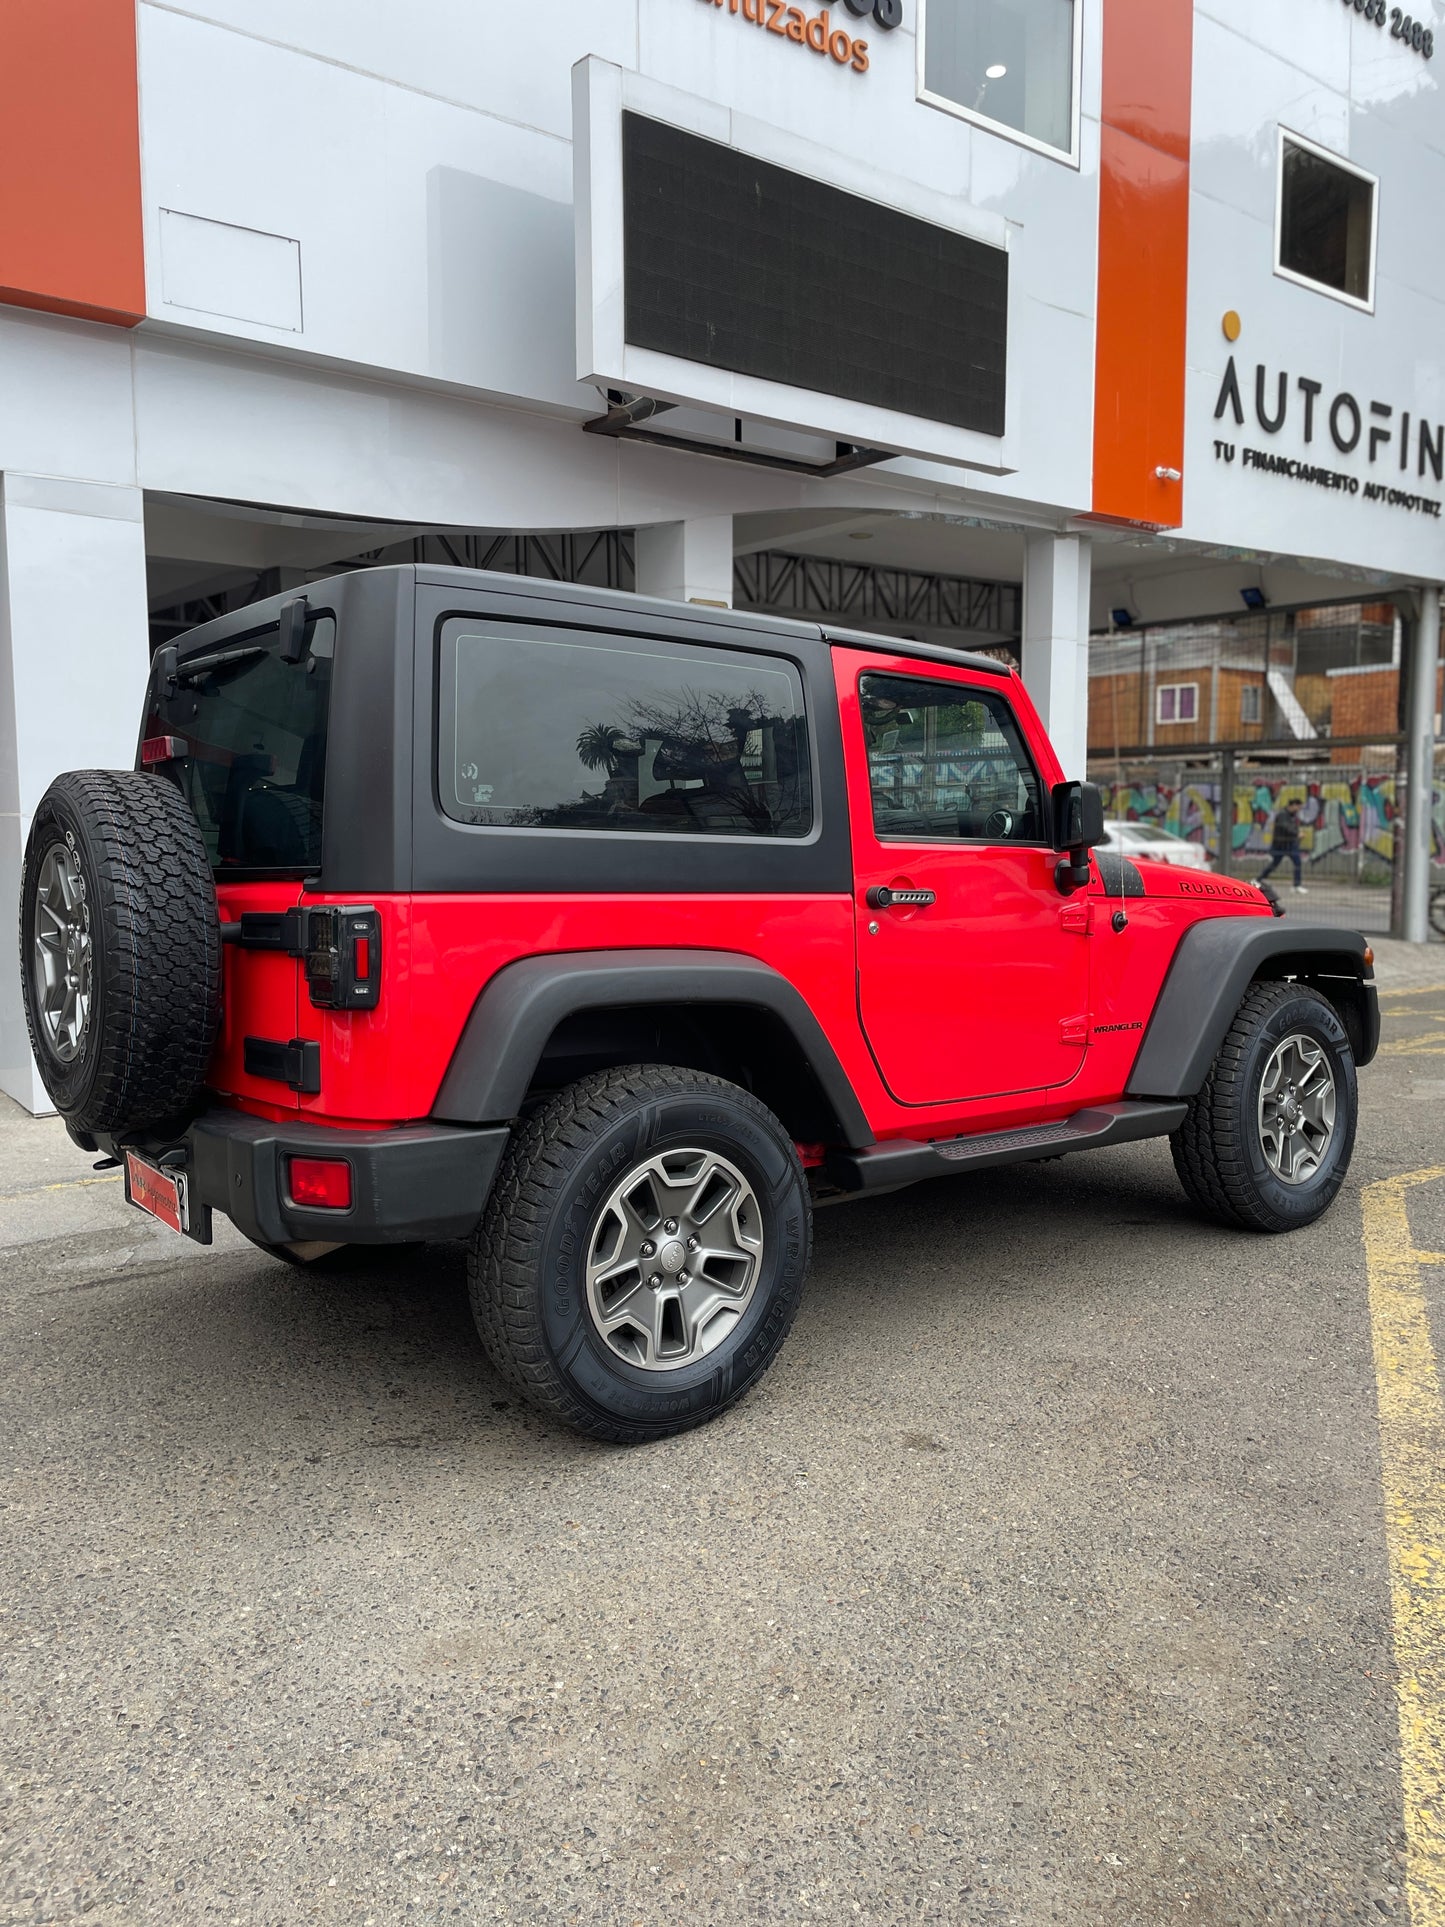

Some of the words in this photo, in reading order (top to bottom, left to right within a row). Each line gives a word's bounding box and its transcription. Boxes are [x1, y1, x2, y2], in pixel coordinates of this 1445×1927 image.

[1391, 7, 1433, 59] 2488
[1214, 355, 1444, 482] AUTOFIN
[1213, 440, 1235, 462] TU
[1242, 448, 1359, 494] FINANCIAMIENTO
[1362, 482, 1441, 518] AUTOMOTRIZ
[1179, 882, 1255, 899] RUBICON
[1094, 1021, 1143, 1034] WRANGLER
